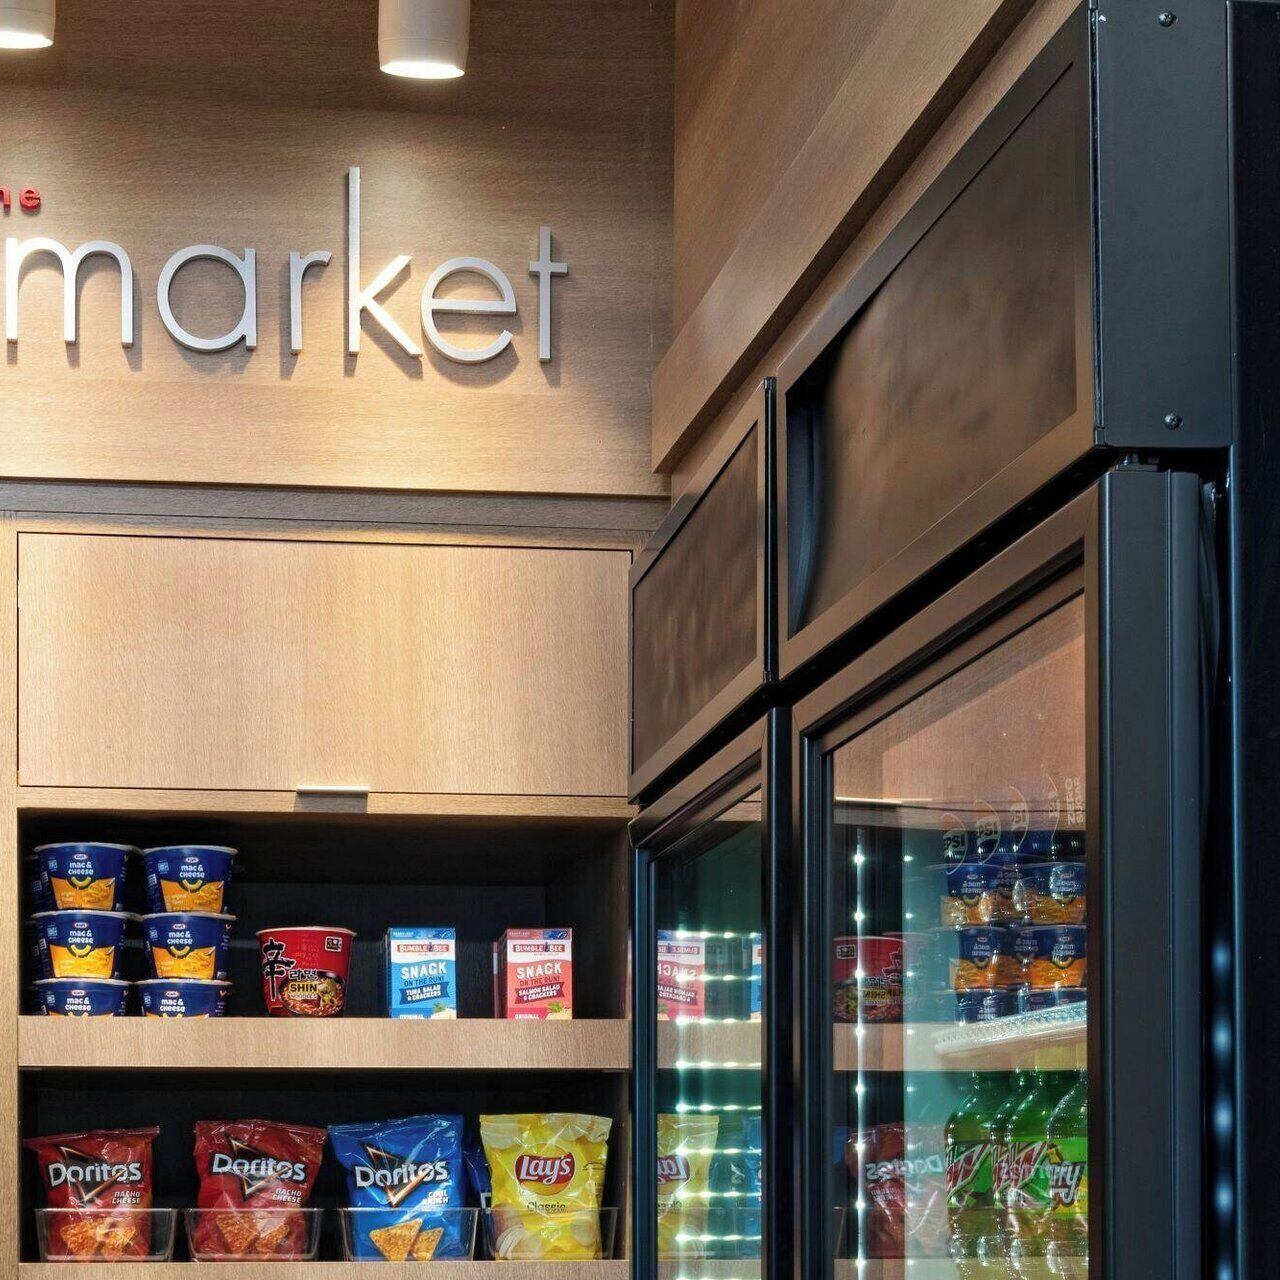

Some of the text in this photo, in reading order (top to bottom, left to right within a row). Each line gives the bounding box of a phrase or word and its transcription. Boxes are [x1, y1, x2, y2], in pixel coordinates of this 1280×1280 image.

[5, 166, 568, 364] market
[943, 834, 966, 850] PSI
[86, 861, 92, 869] &
[168, 931, 185, 939] mac
[399, 944, 448, 952] BUMBLE BEE
[514, 944, 563, 952] BUMBLE BEE
[262, 936, 297, 1002] 辛
[401, 961, 447, 980] SNACK
[516, 961, 562, 979] SNACK
[290, 983, 318, 992] SHIN
[519, 979, 529, 987] ON
[518, 984, 560, 996] SALMON SALAD
[528, 990, 557, 1000] CRACKERS
[212, 1153, 305, 1182] Doritos
[519, 1155, 572, 1185] Lay's
[48, 1162, 141, 1187] Doritos
[355, 1160, 448, 1188] Doritos
[275, 1187, 303, 1197] NACHO
[427, 1190, 448, 1198] COOL
[272, 1193, 302, 1204] CHEESE
[526, 1201, 566, 1212] Classic
